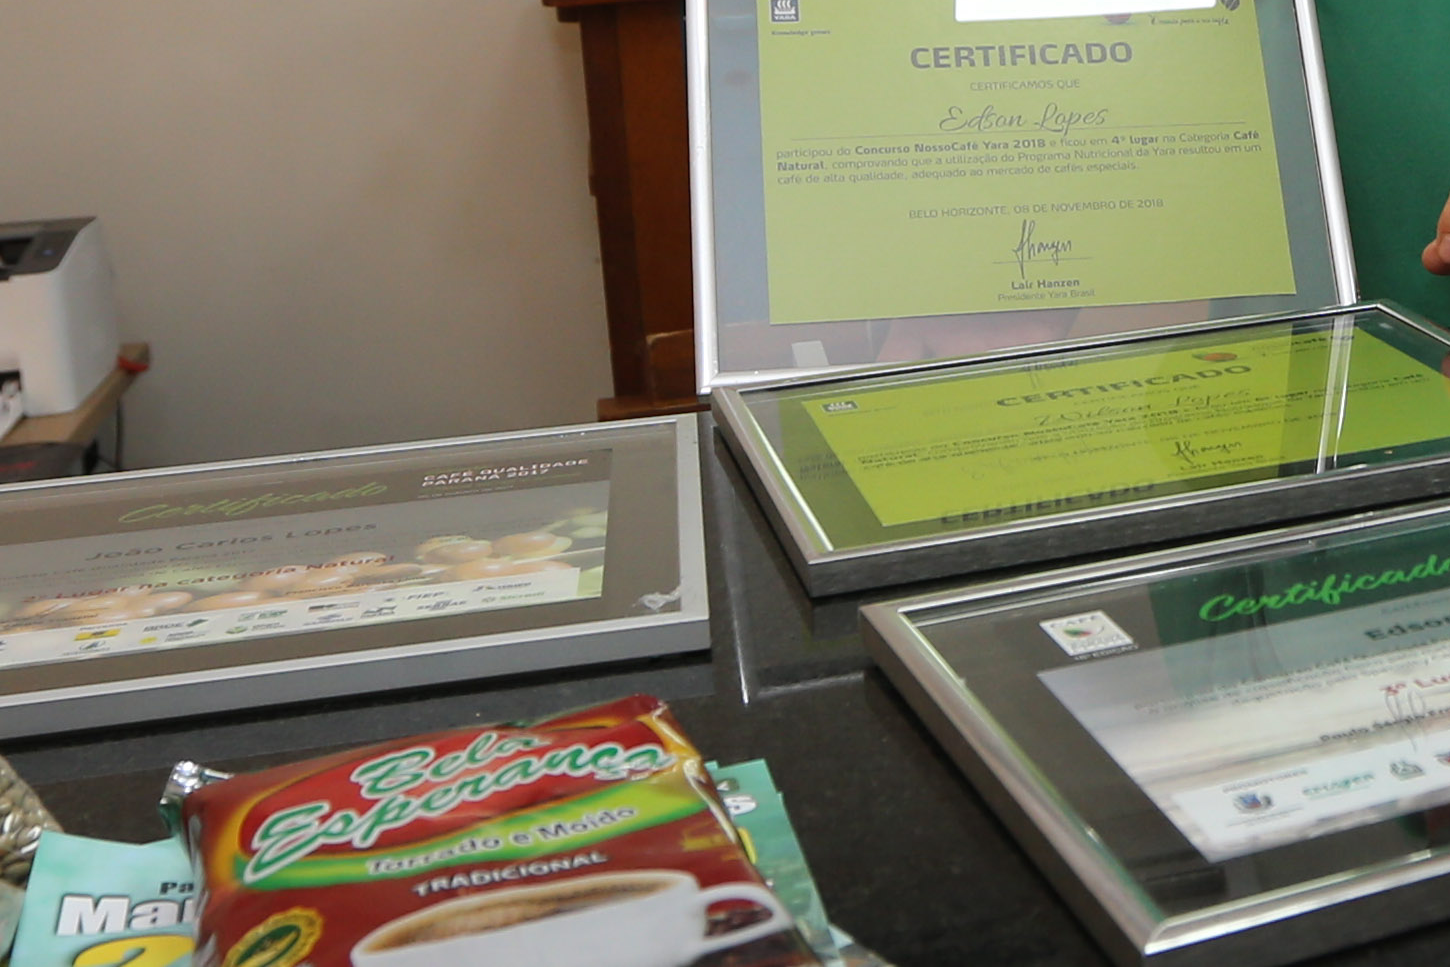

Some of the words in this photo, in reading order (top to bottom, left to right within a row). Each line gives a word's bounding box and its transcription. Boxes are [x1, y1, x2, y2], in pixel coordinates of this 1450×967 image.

[911, 42, 1132, 69] CERTIFICADO
[970, 80, 1053, 91] CERTIFICAMOS
[1057, 79, 1080, 89] QUE
[939, 105, 1026, 131] Edson
[1034, 102, 1109, 135] Lopes
[776, 146, 832, 159] participou
[837, 147, 850, 155] do
[855, 144, 910, 155] Concurso
[914, 140, 978, 153] NossoCafé
[983, 140, 1009, 150] Yara
[1013, 139, 1046, 149] 2018
[1060, 137, 1086, 147] ficou
[1090, 137, 1107, 145] em
[1130, 135, 1159, 146] lugar
[1163, 135, 1176, 143] na
[1179, 132, 1230, 144] Categoria
[1233, 130, 1259, 140] Café
[832, 158, 908, 171] comprovando
[911, 157, 932, 168] que
[945, 153, 998, 165] utilização
[1001, 153, 1014, 162] do
[1018, 151, 1070, 163] Programa
[1074, 148, 1133, 159] Nutricional
[1136, 147, 1149, 157] da
[1153, 146, 1175, 156] Yara
[1178, 144, 1221, 155] resultou
[1224, 144, 1242, 153] em
[1244, 143, 1261, 152] um
[777, 174, 800, 184] café
[805, 174, 819, 183] de
[823, 173, 845, 182] alta
[911, 167, 966, 180] adequado
[970, 168, 983, 176] ao
[987, 164, 1034, 175] mercado
[1037, 164, 1051, 174] de
[1054, 162, 1083, 173] cafés
[909, 210, 937, 219] BELO
[1033, 204, 1048, 213] DE
[1051, 201, 1116, 212] NOVEMBRO
[1119, 200, 1135, 209] DE
[1137, 198, 1164, 209] 2018
[998, 291, 1045, 302] Presidente
[1048, 290, 1068, 300] Yara
[1070, 289, 1095, 298] Brasil
[1011, 281, 1033, 290] Lair
[1037, 278, 1080, 289] Hanzen
[996, 365, 1252, 408] CERTIFICADO
[423, 469, 475, 481] CAFÉ
[480, 458, 589, 476] QUALIDADE
[507, 469, 549, 480] 2017
[118, 482, 388, 524] Certificado
[86, 545, 163, 561] João
[175, 533, 273, 551] Carlos
[286, 522, 377, 539] Lopes
[138, 581, 168, 591] na
[177, 565, 297, 586] categoria
[304, 555, 395, 572] Natural
[352, 732, 553, 799] Bela
[243, 741, 677, 883] Esperança
[367, 835, 501, 876] Torrado
[510, 830, 531, 847] e
[535, 806, 637, 842] Moído
[411, 852, 608, 898] TRADICIONAL
